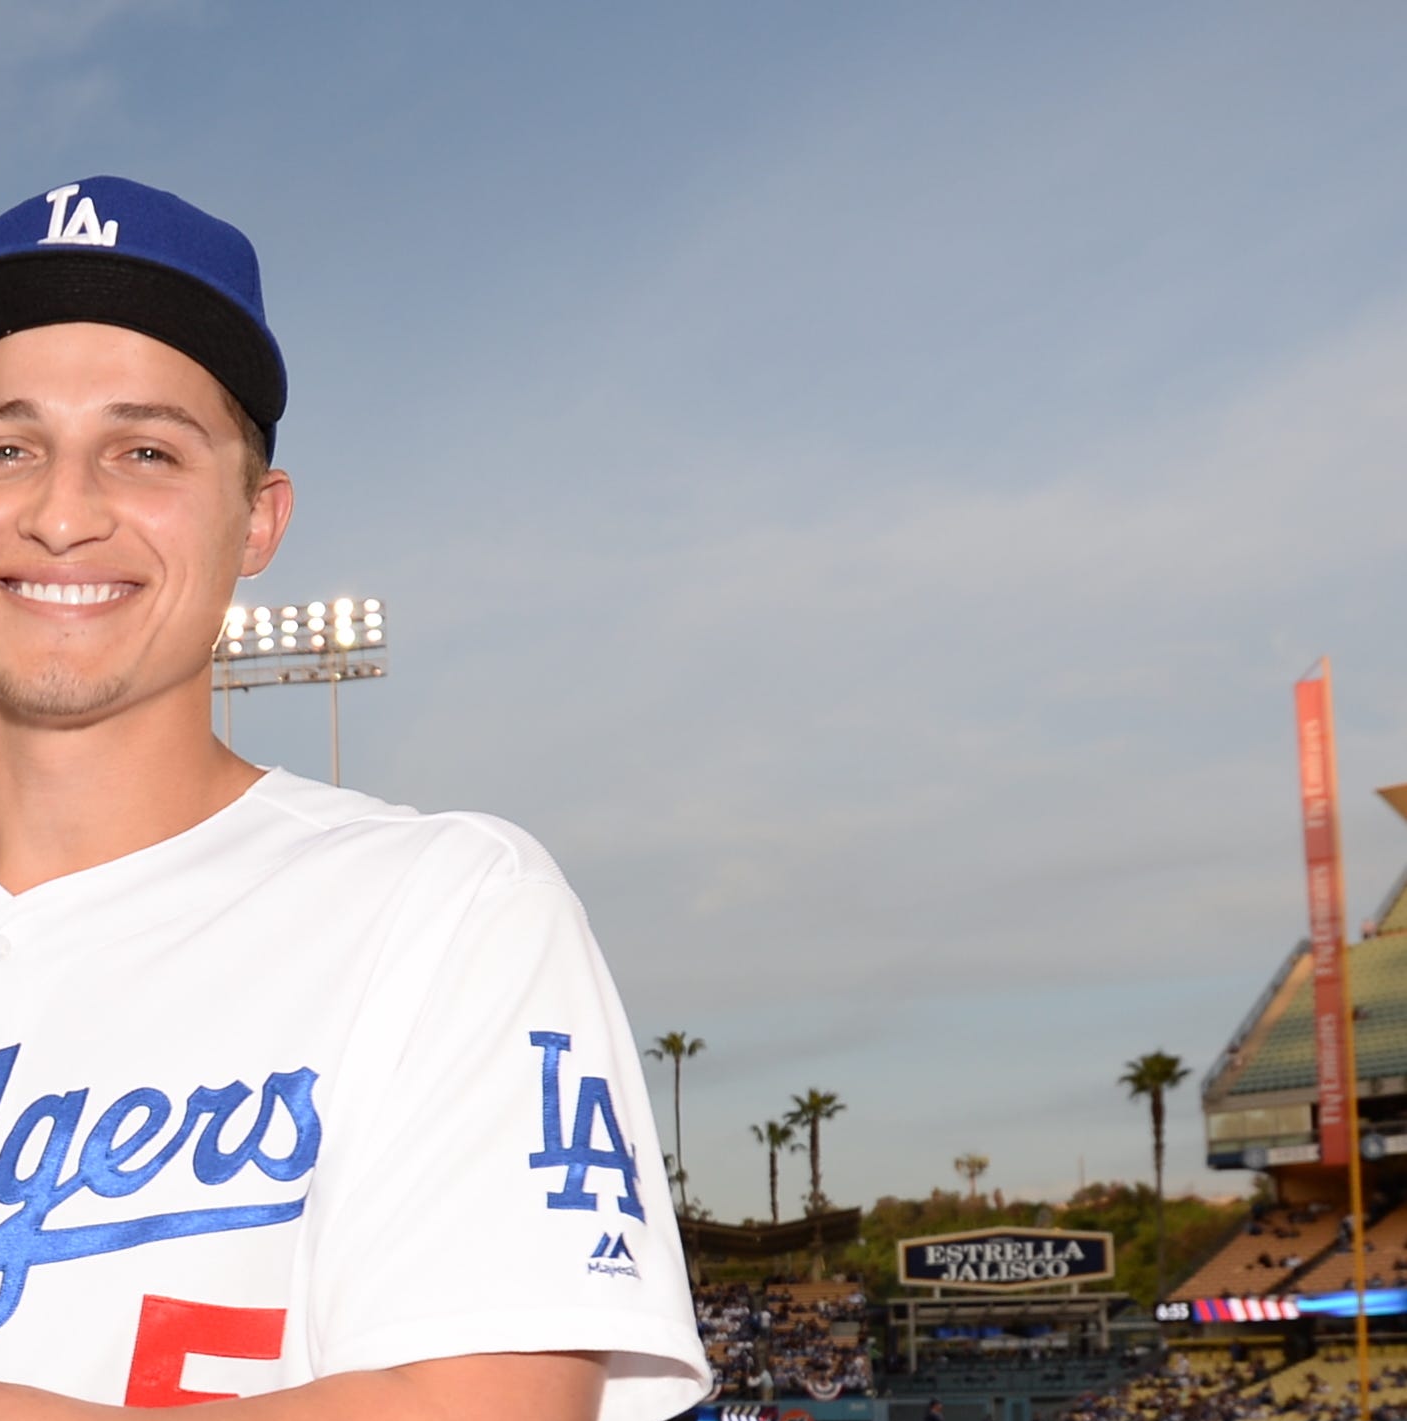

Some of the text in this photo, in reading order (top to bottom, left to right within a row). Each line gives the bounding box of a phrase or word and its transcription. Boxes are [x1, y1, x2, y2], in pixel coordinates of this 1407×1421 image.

[37, 183, 119, 247] LA
[529, 1030, 647, 1225] LA
[925, 1240, 1085, 1266] ESTRELLA
[940, 1259, 1071, 1282] JALISCO
